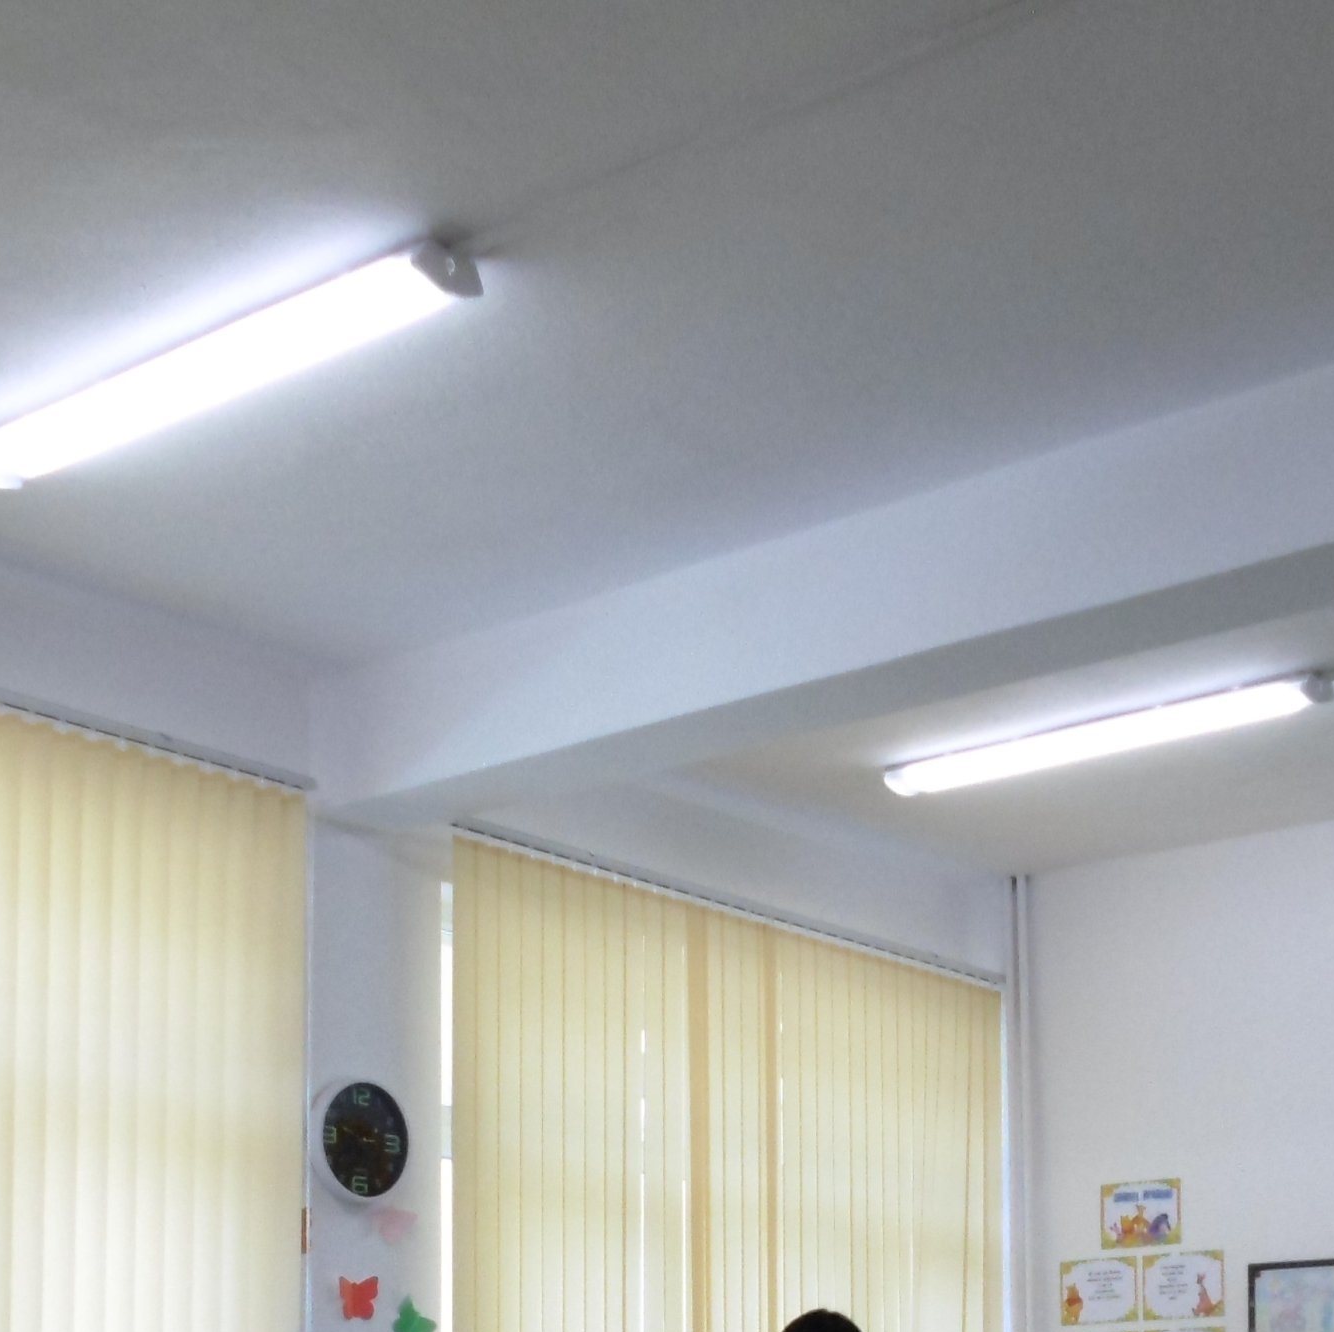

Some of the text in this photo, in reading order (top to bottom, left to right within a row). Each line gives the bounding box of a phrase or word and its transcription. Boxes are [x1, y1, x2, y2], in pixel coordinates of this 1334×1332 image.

[352, 1087, 371, 1107] 12
[383, 1132, 402, 1154] 3
[351, 1175, 369, 1195] 6
